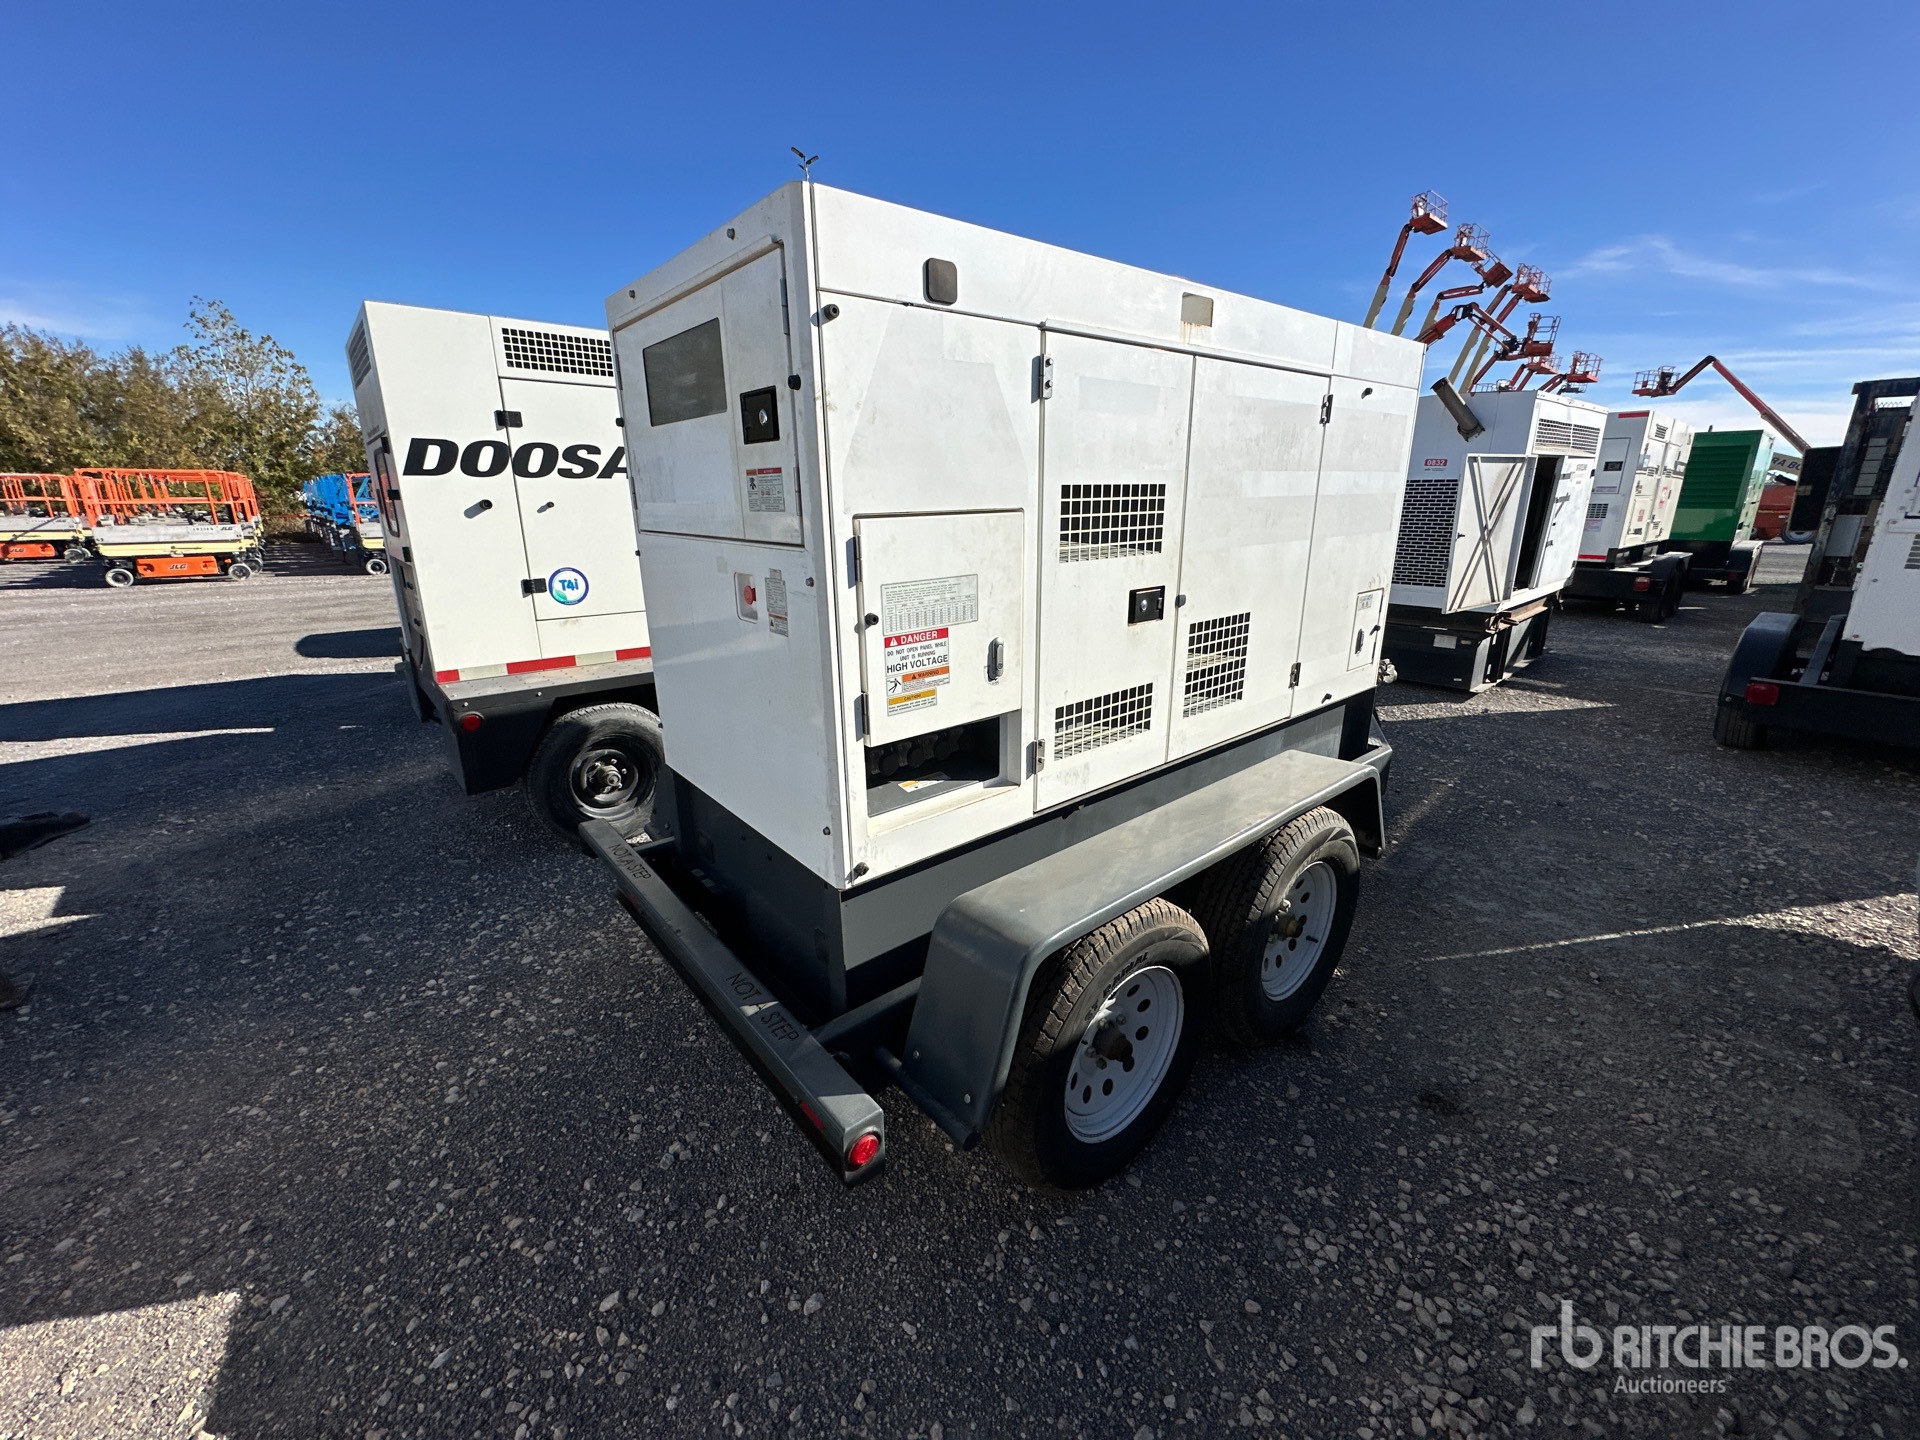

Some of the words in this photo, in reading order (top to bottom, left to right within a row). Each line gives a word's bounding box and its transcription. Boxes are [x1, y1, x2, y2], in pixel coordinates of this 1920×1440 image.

[901, 630, 938, 645] DANGER
[886, 662, 908, 673] HIGH
[910, 654, 948, 669] VOLTAGE
[918, 670, 940, 678] WARNING
[608, 844, 633, 860] NOT
[627, 864, 652, 879] STEP
[725, 972, 762, 1000] NOT
[761, 1011, 799, 1041] STEP
